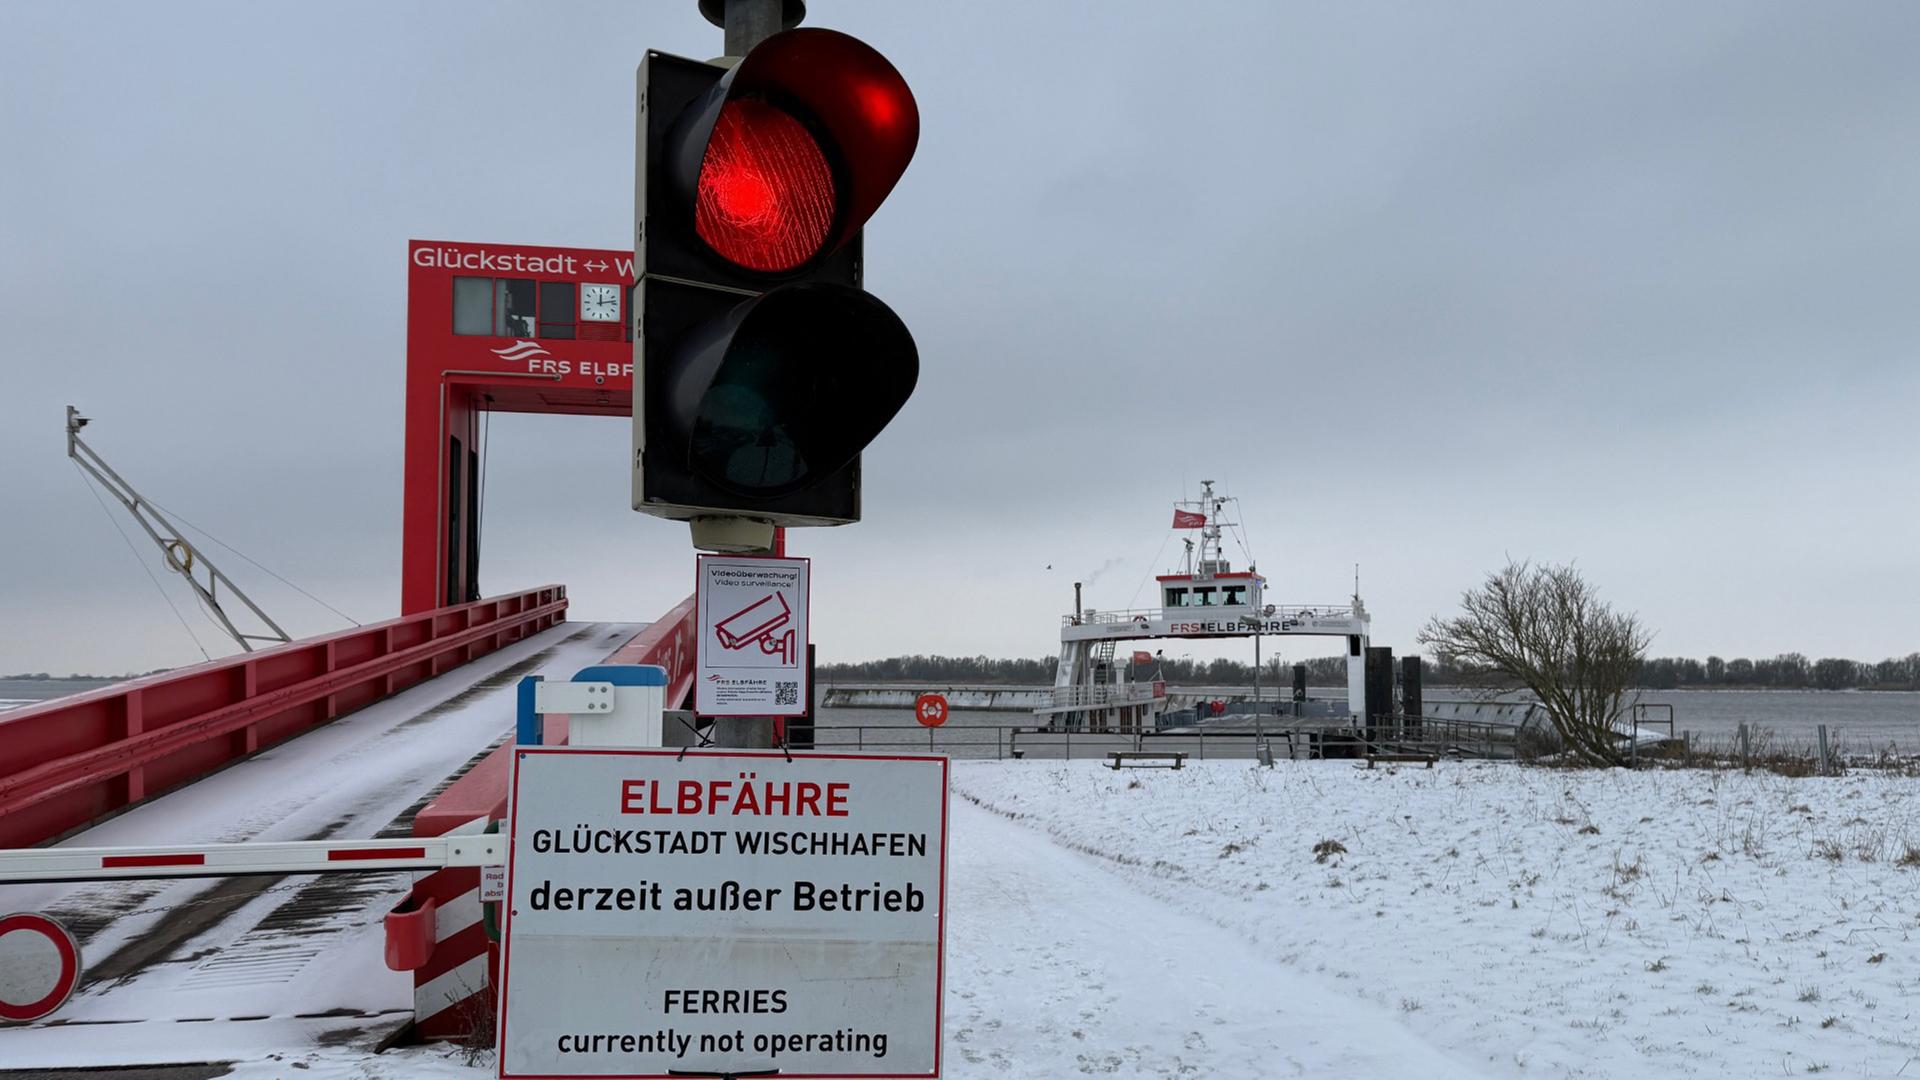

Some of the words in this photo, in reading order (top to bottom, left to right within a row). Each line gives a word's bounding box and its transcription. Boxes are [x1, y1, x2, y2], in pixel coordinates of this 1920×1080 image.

[413, 247, 577, 275] Glückstadt
[528, 359, 571, 375] FRS
[711, 570, 797, 580] Videoüberwachung!
[714, 578, 739, 587] Video
[1170, 623, 1200, 633] FRS
[622, 773, 849, 816] ELBFÄHRE
[533, 824, 727, 855] GLÜCKSTADT
[735, 831, 926, 857] WISCHHAFEN
[531, 881, 662, 912] derzeit
[674, 881, 782, 912] außer
[794, 882, 925, 913] Betrieb
[664, 989, 788, 1014] FERRIES
[558, 1029, 692, 1058] currently
[701, 1029, 745, 1054] not
[754, 1028, 888, 1058] operating
